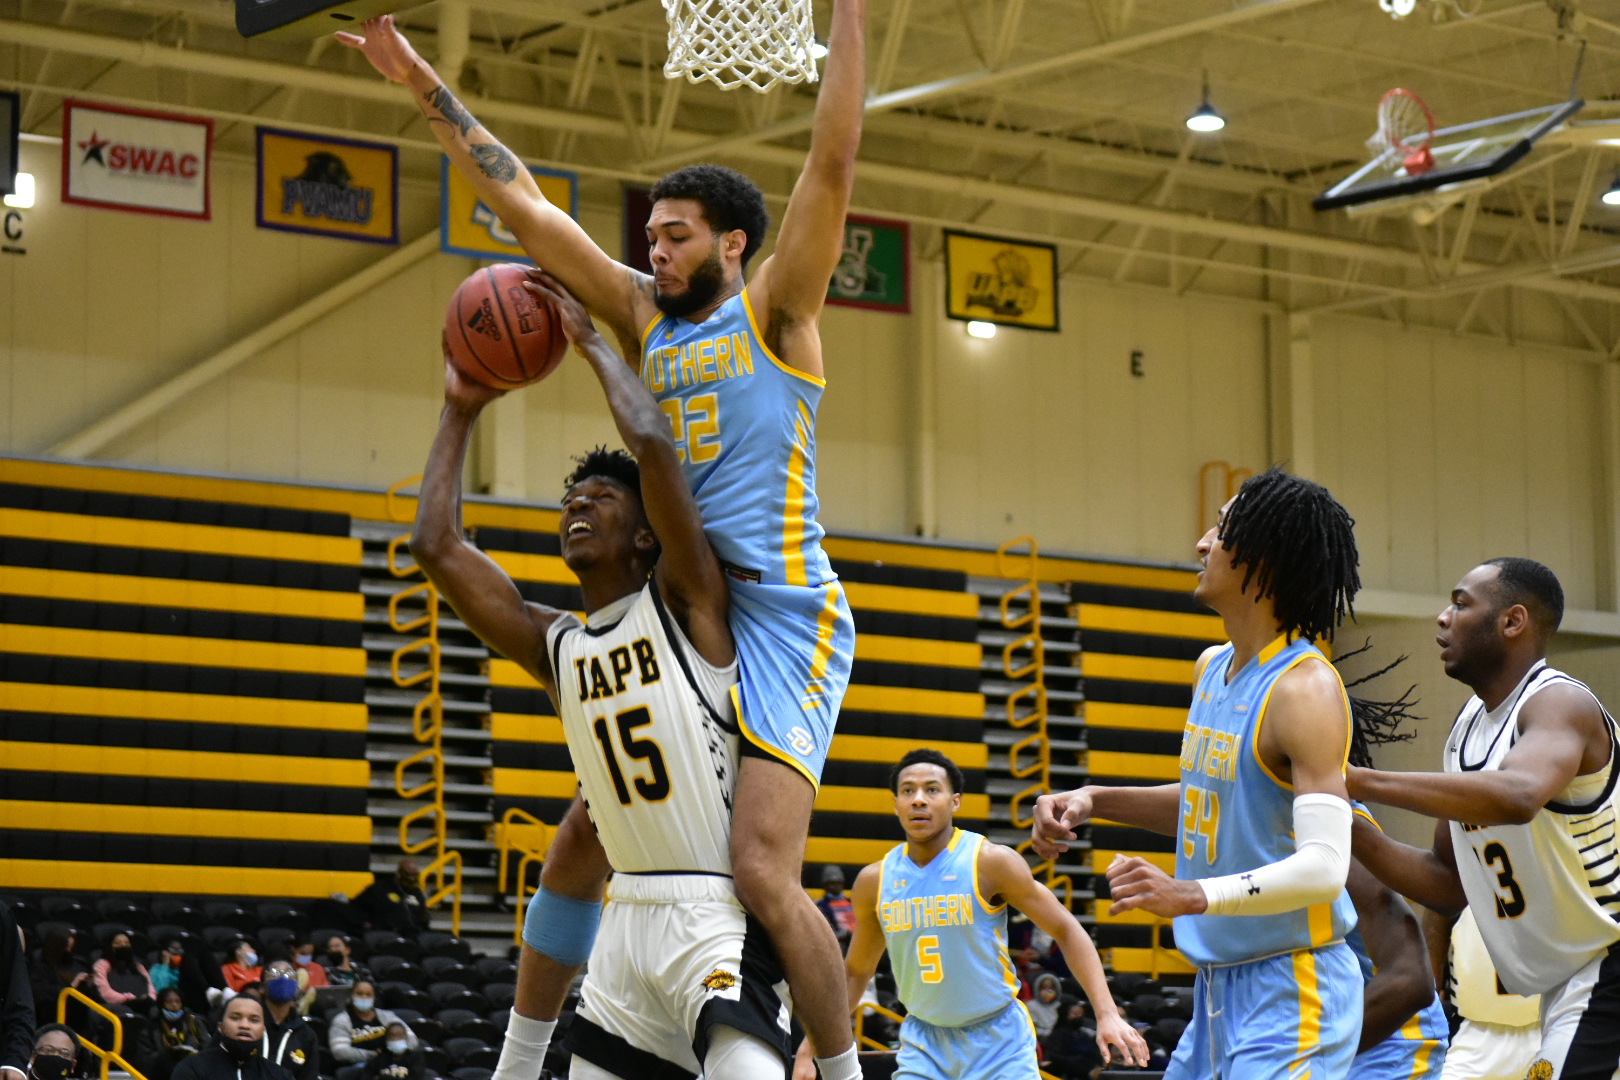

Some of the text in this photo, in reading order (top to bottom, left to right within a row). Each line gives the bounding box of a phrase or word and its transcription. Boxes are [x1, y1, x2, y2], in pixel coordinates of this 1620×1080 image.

[107, 144, 199, 179] SWAC
[481, 297, 502, 342] adidas
[644, 330, 755, 394] UTHERN
[1130, 350, 1145, 378] E
[593, 703, 673, 807] 15
[1183, 783, 1220, 866] 24
[880, 893, 974, 933] SOUTHERN
[916, 934, 945, 984] 5
